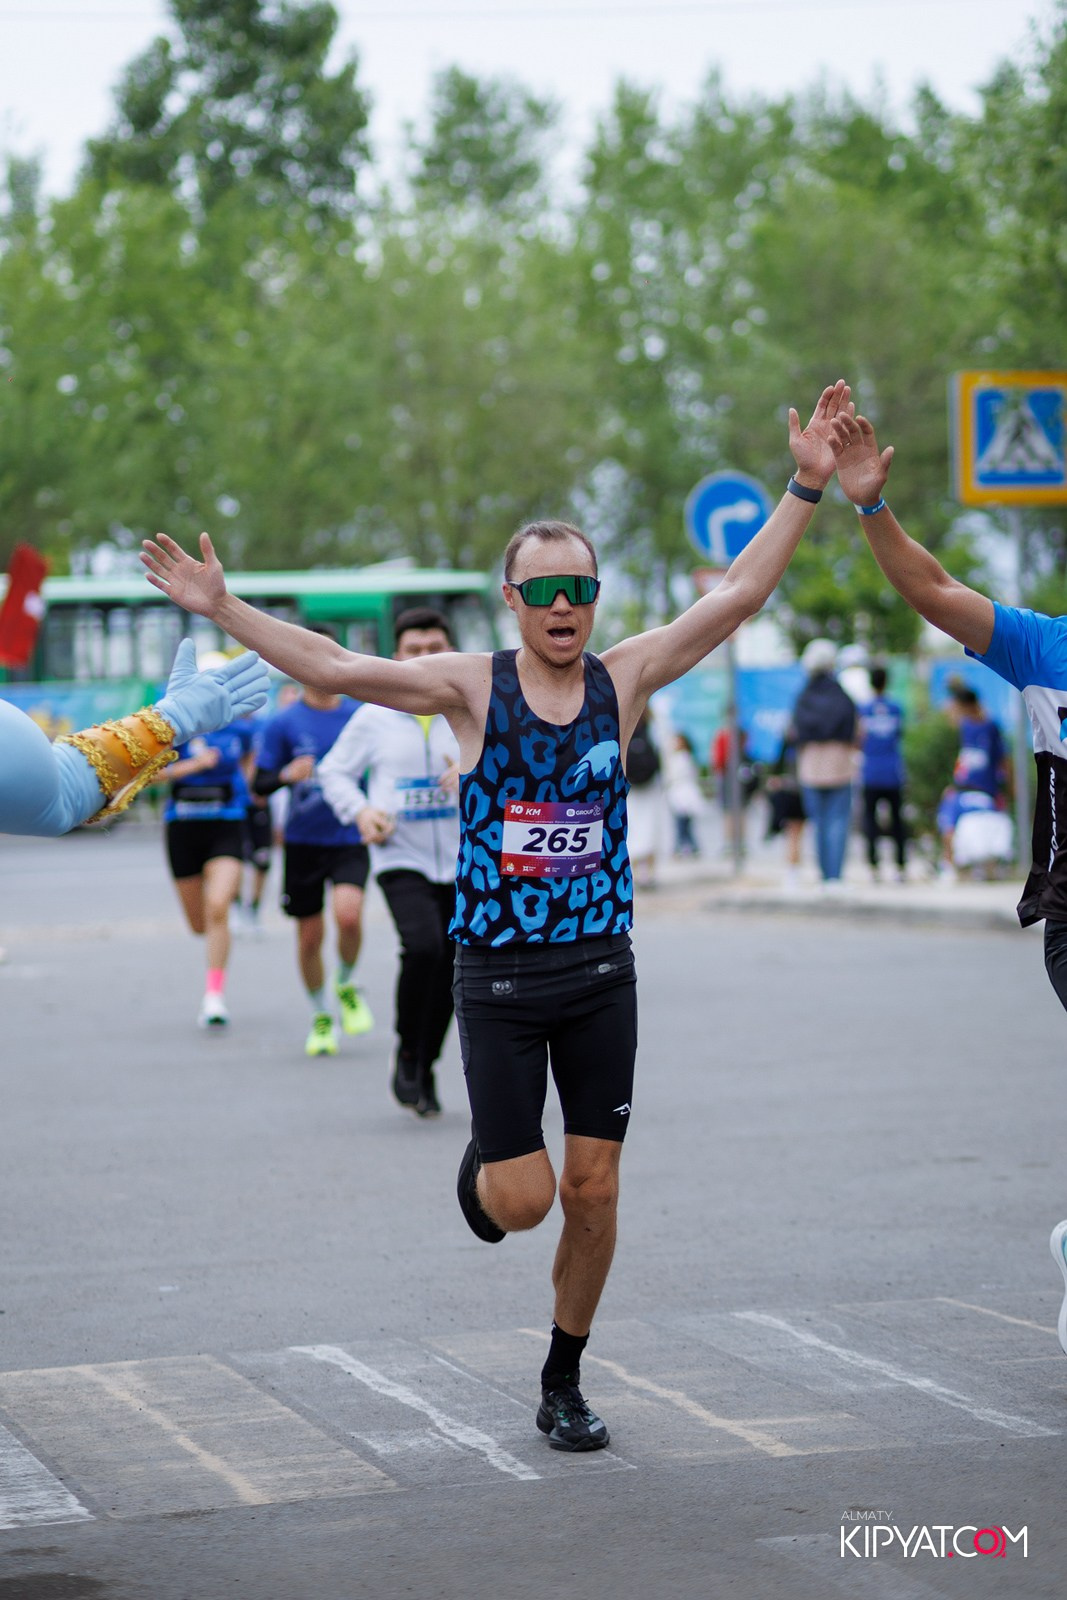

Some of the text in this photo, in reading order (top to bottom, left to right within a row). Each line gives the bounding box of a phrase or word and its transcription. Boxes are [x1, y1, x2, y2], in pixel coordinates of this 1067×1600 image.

[510, 804, 541, 816] 10 KM
[522, 827, 591, 853] 265
